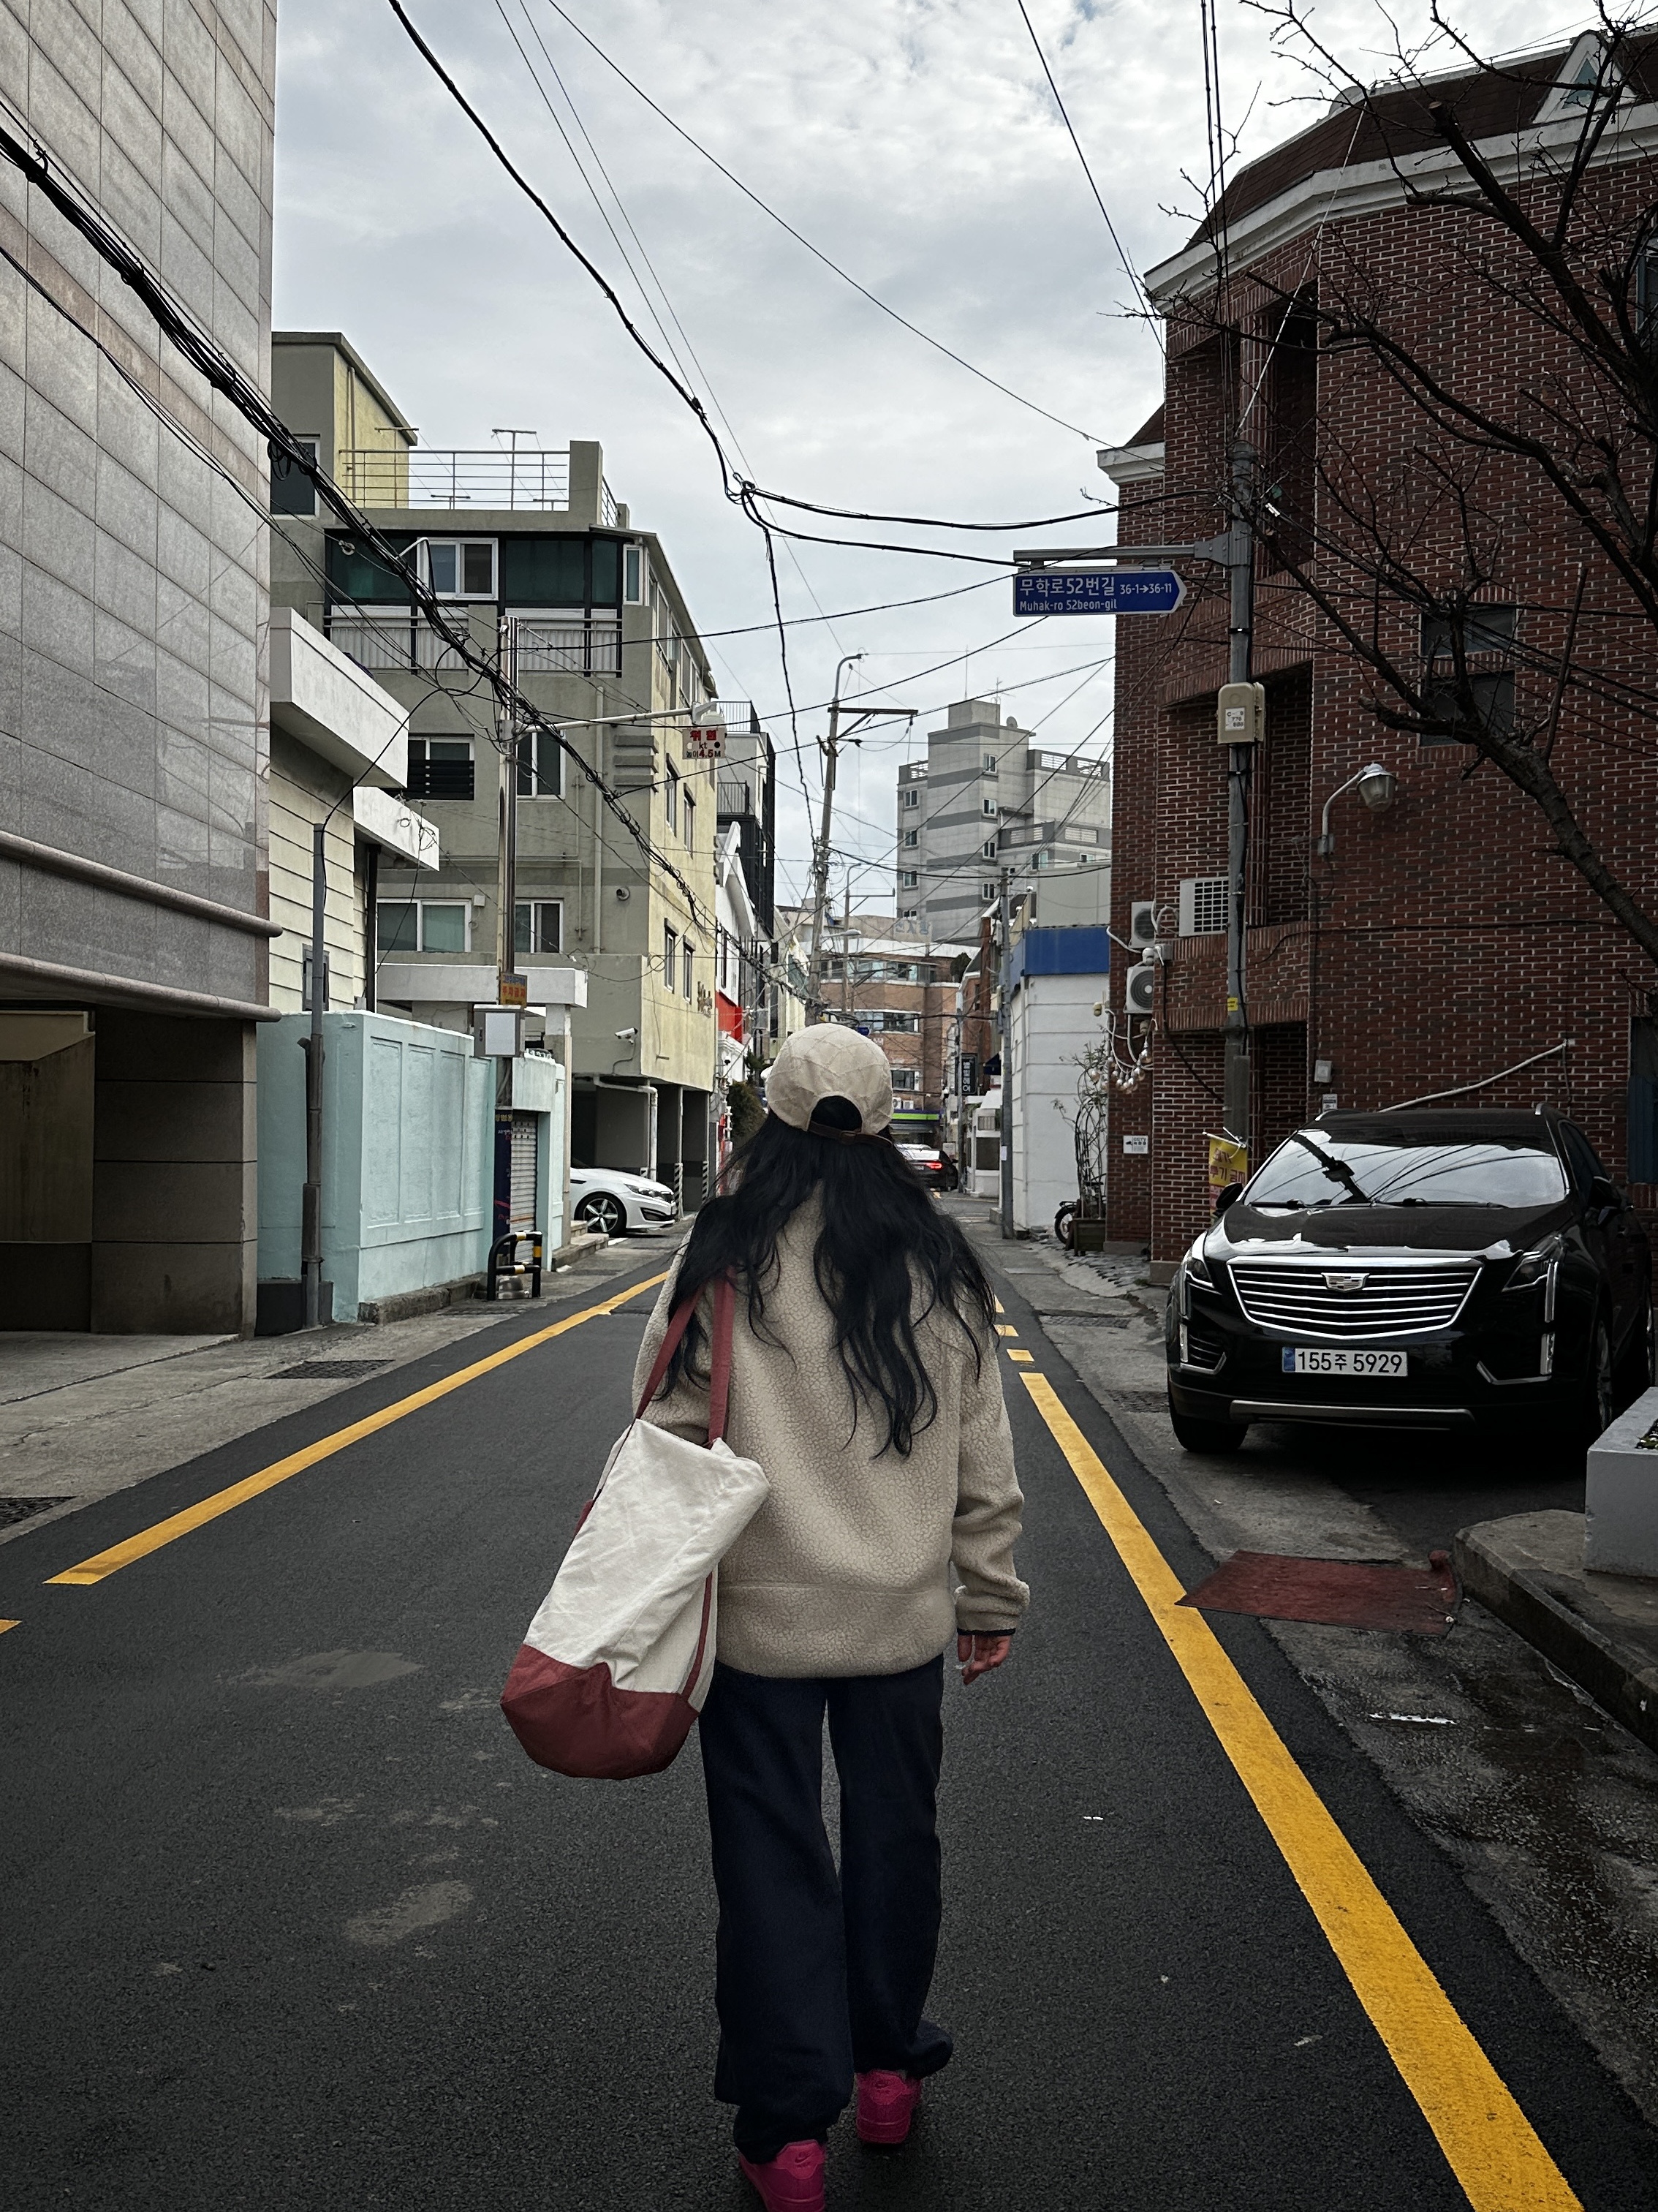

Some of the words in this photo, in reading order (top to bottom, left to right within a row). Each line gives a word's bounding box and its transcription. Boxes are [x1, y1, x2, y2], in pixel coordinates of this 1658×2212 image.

[1020, 576, 1115, 597] 무학로52번길
[1020, 600, 1064, 611] Muhak-ro
[1066, 598, 1117, 611] 52beon-gil
[1298, 1351, 1347, 1371] 155주
[1352, 1353, 1403, 1373] 5929
